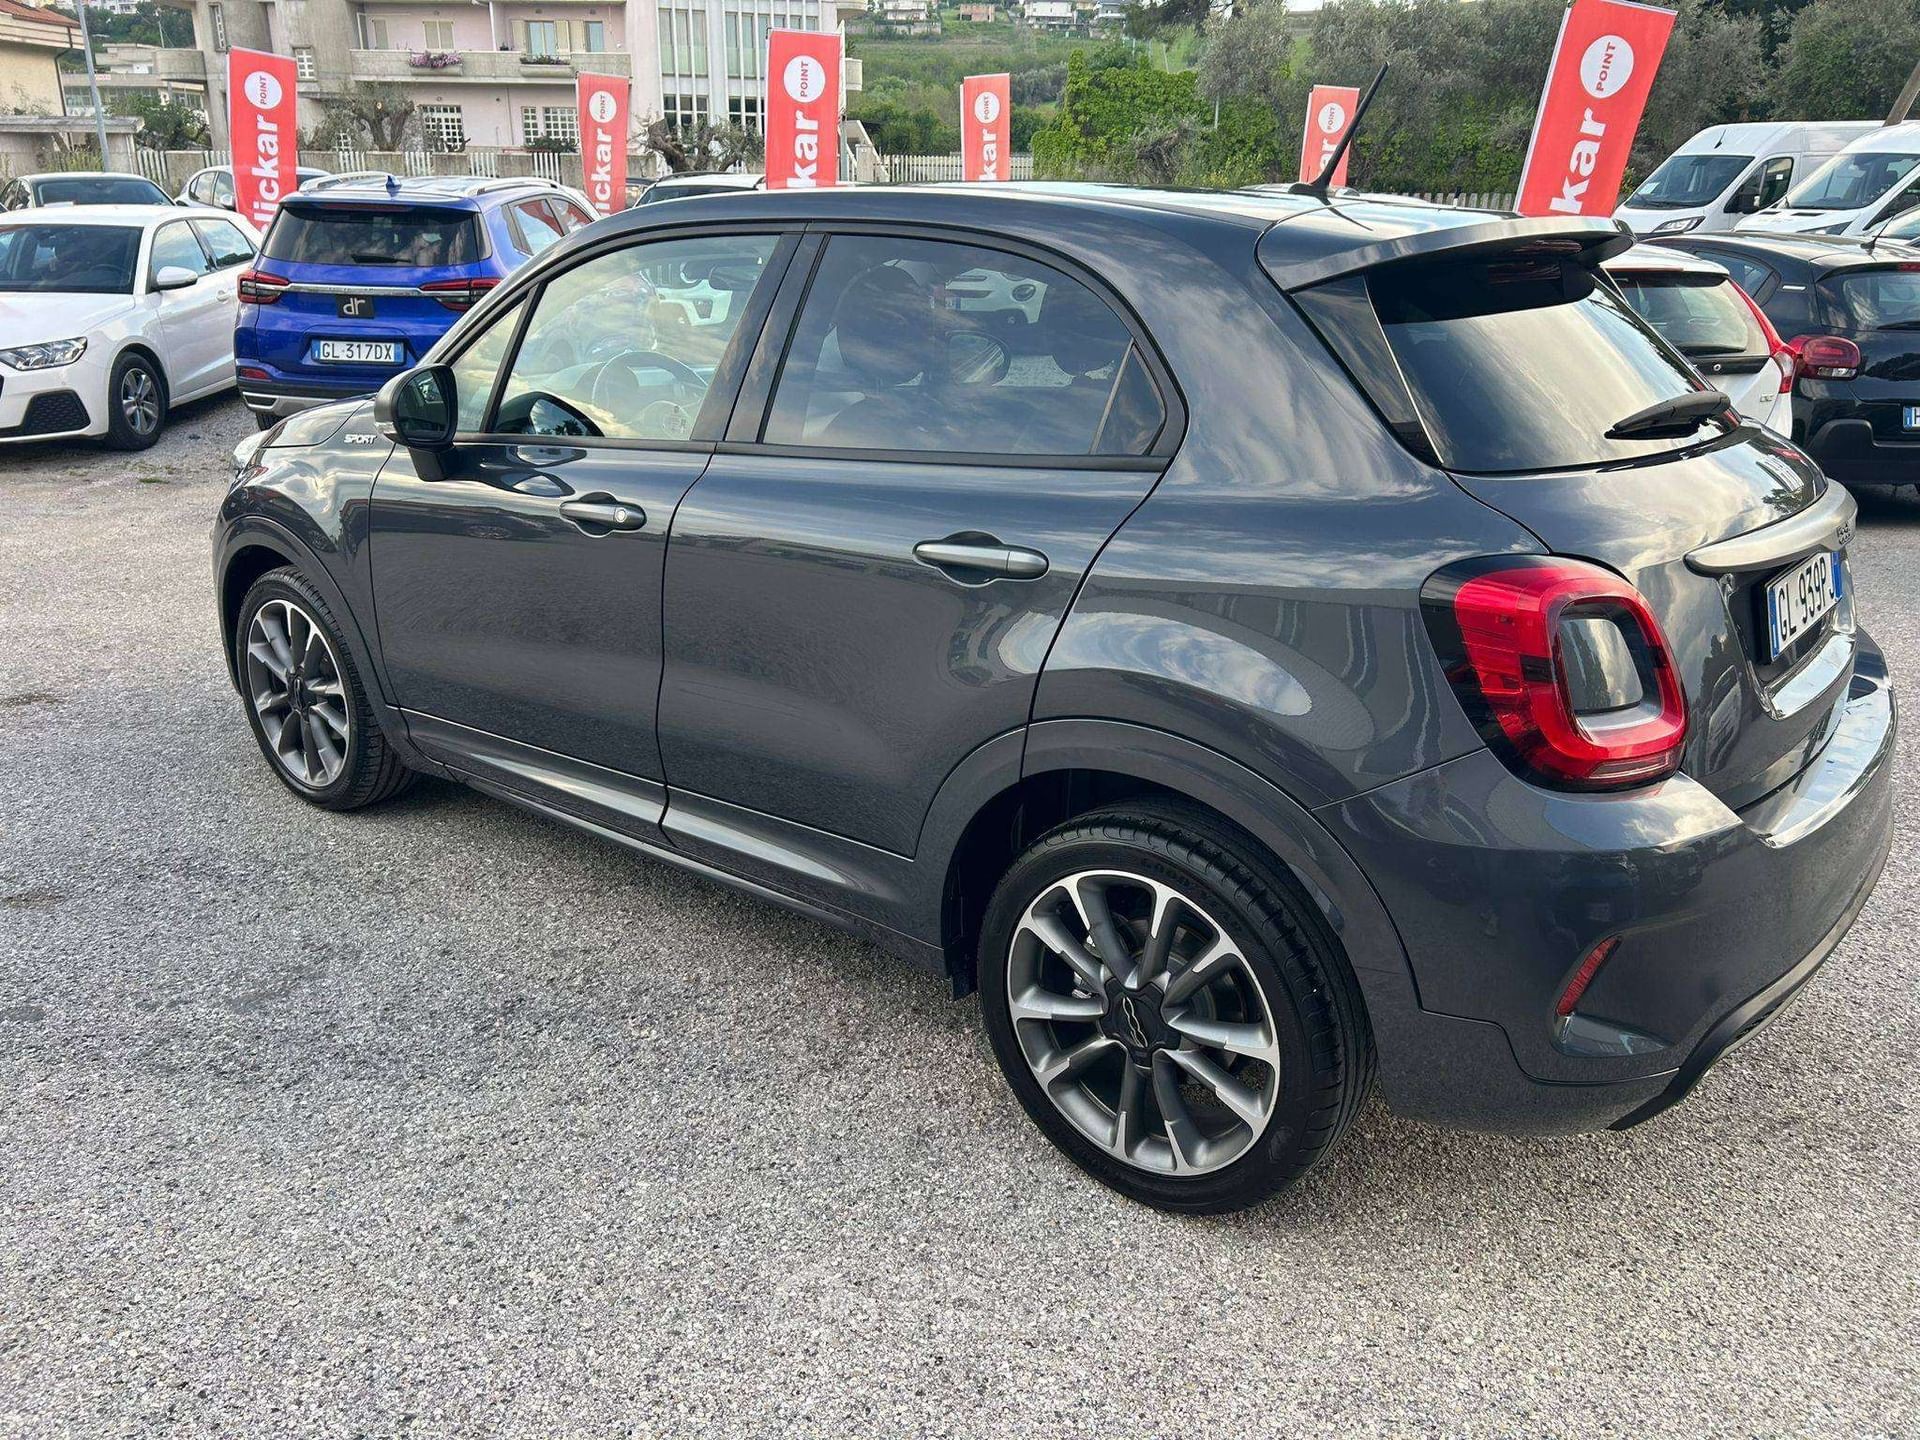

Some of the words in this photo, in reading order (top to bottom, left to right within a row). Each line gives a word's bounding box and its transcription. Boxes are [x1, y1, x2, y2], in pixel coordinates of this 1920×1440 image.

[259, 75, 267, 105] POINT
[800, 61, 809, 97] POINT
[1327, 106, 1336, 130] POINT
[1549, 107, 1607, 214] kar
[1596, 42, 1616, 91] POINT
[786, 110, 818, 187] kar
[979, 128, 997, 181] kar
[251, 113, 280, 234] lickar
[342, 297, 366, 315] dr
[322, 342, 340, 359] GL
[345, 343, 392, 360] 317DX
[343, 433, 377, 444] SPORT
[1778, 581, 1797, 641] GL
